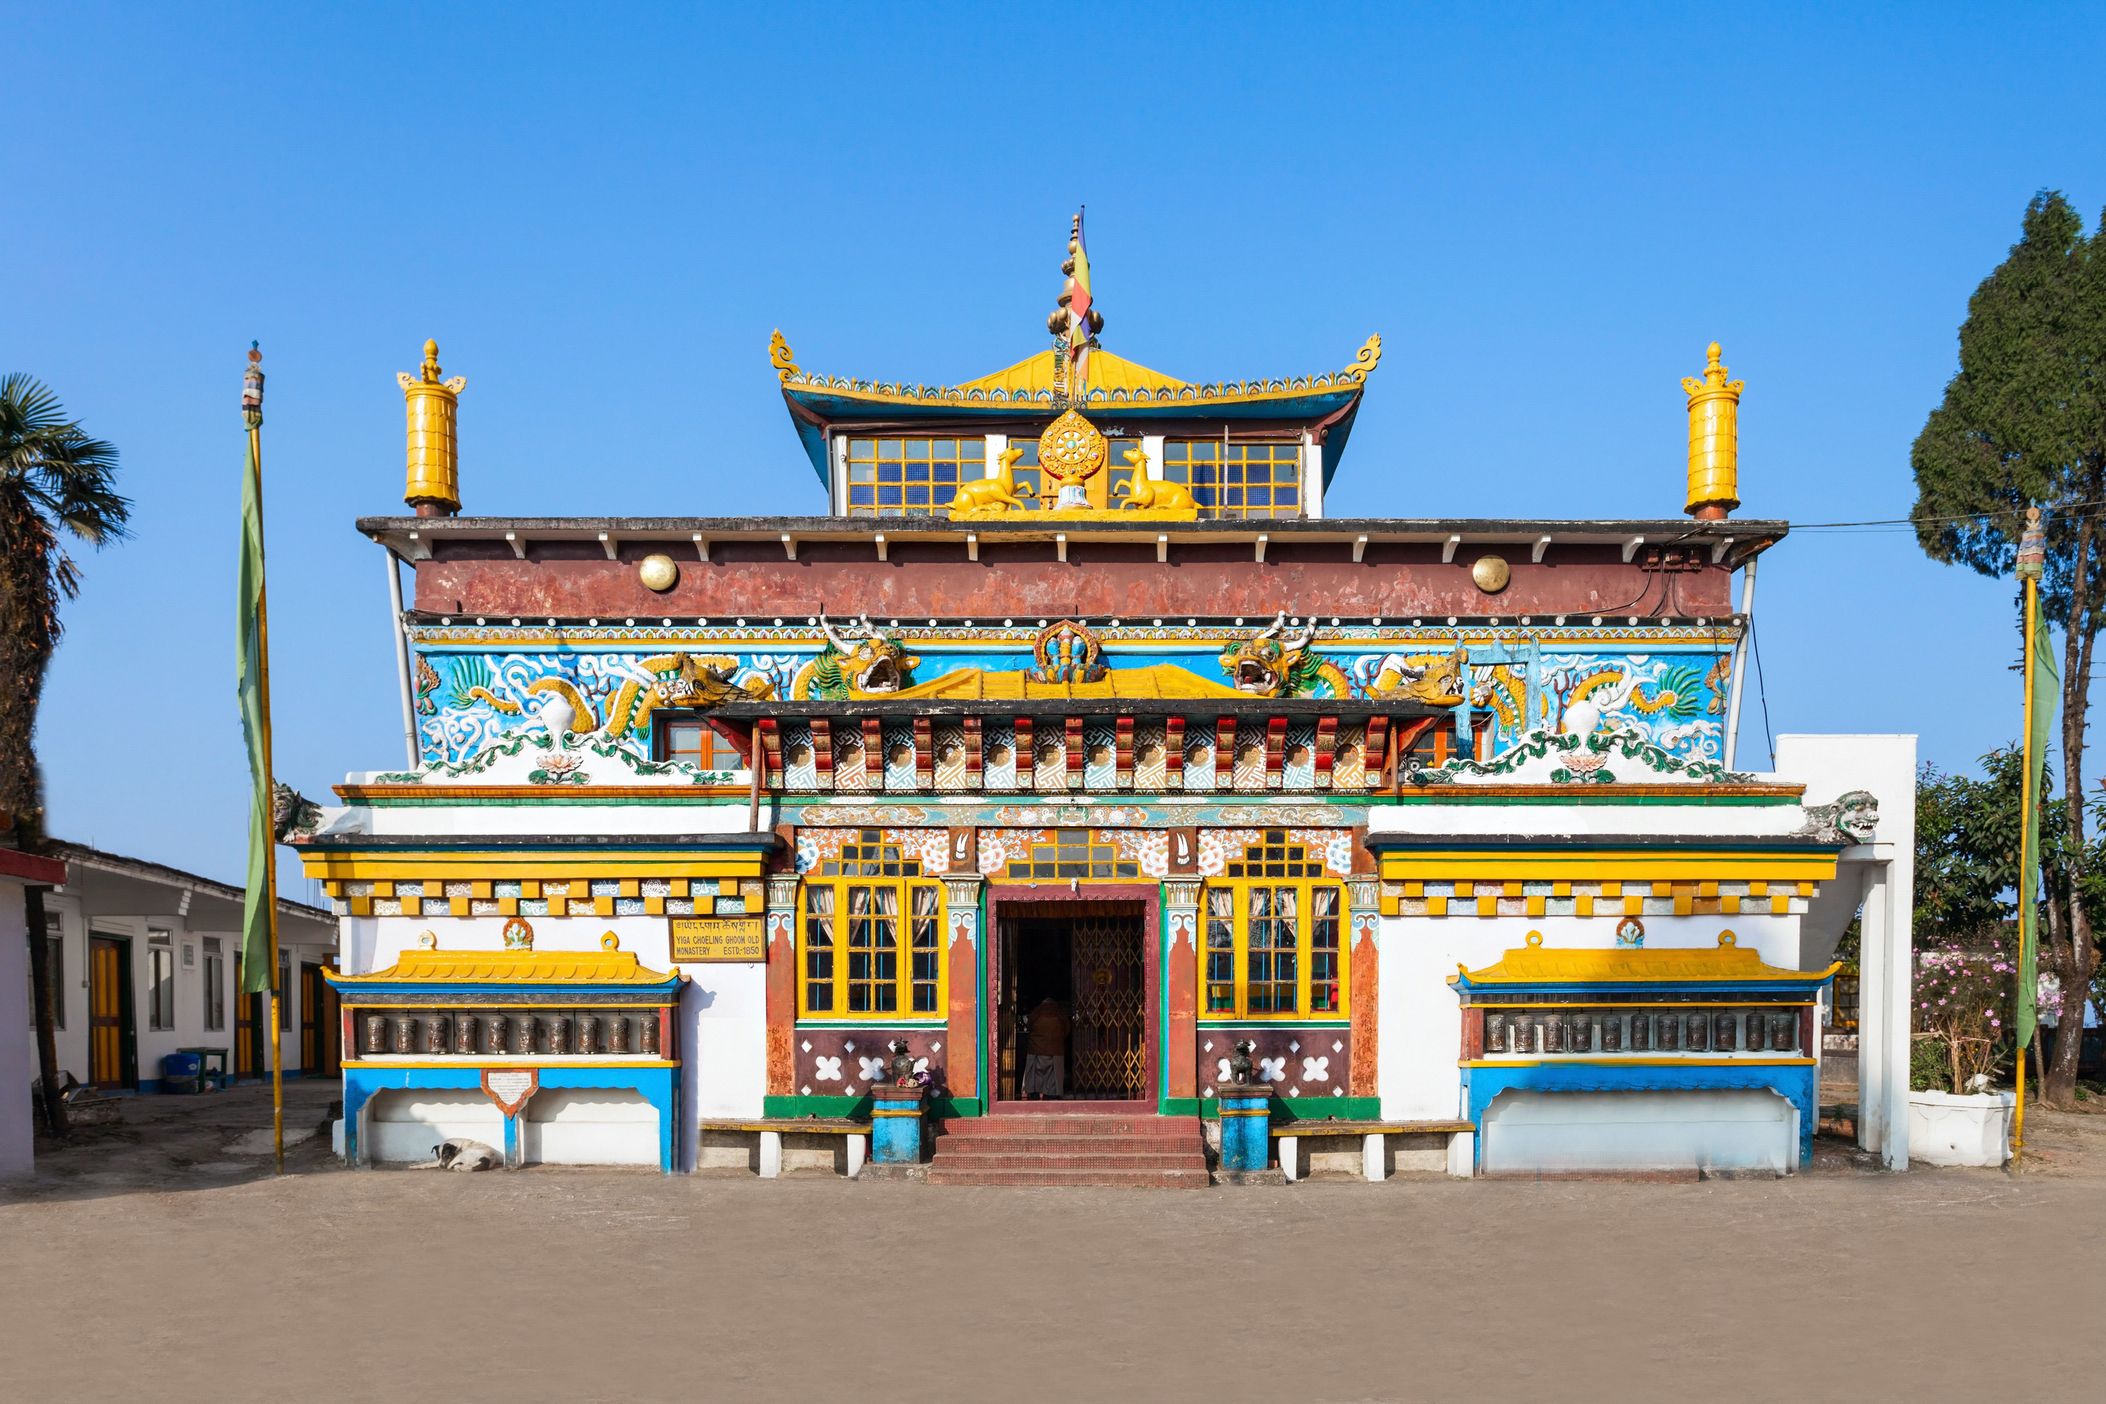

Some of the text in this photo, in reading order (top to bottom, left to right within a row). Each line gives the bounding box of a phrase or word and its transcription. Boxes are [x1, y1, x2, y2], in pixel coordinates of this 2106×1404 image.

[676, 936, 759, 944] YIGA CHOELING GHOOM OLD
[677, 947, 710, 955] MONASTERY
